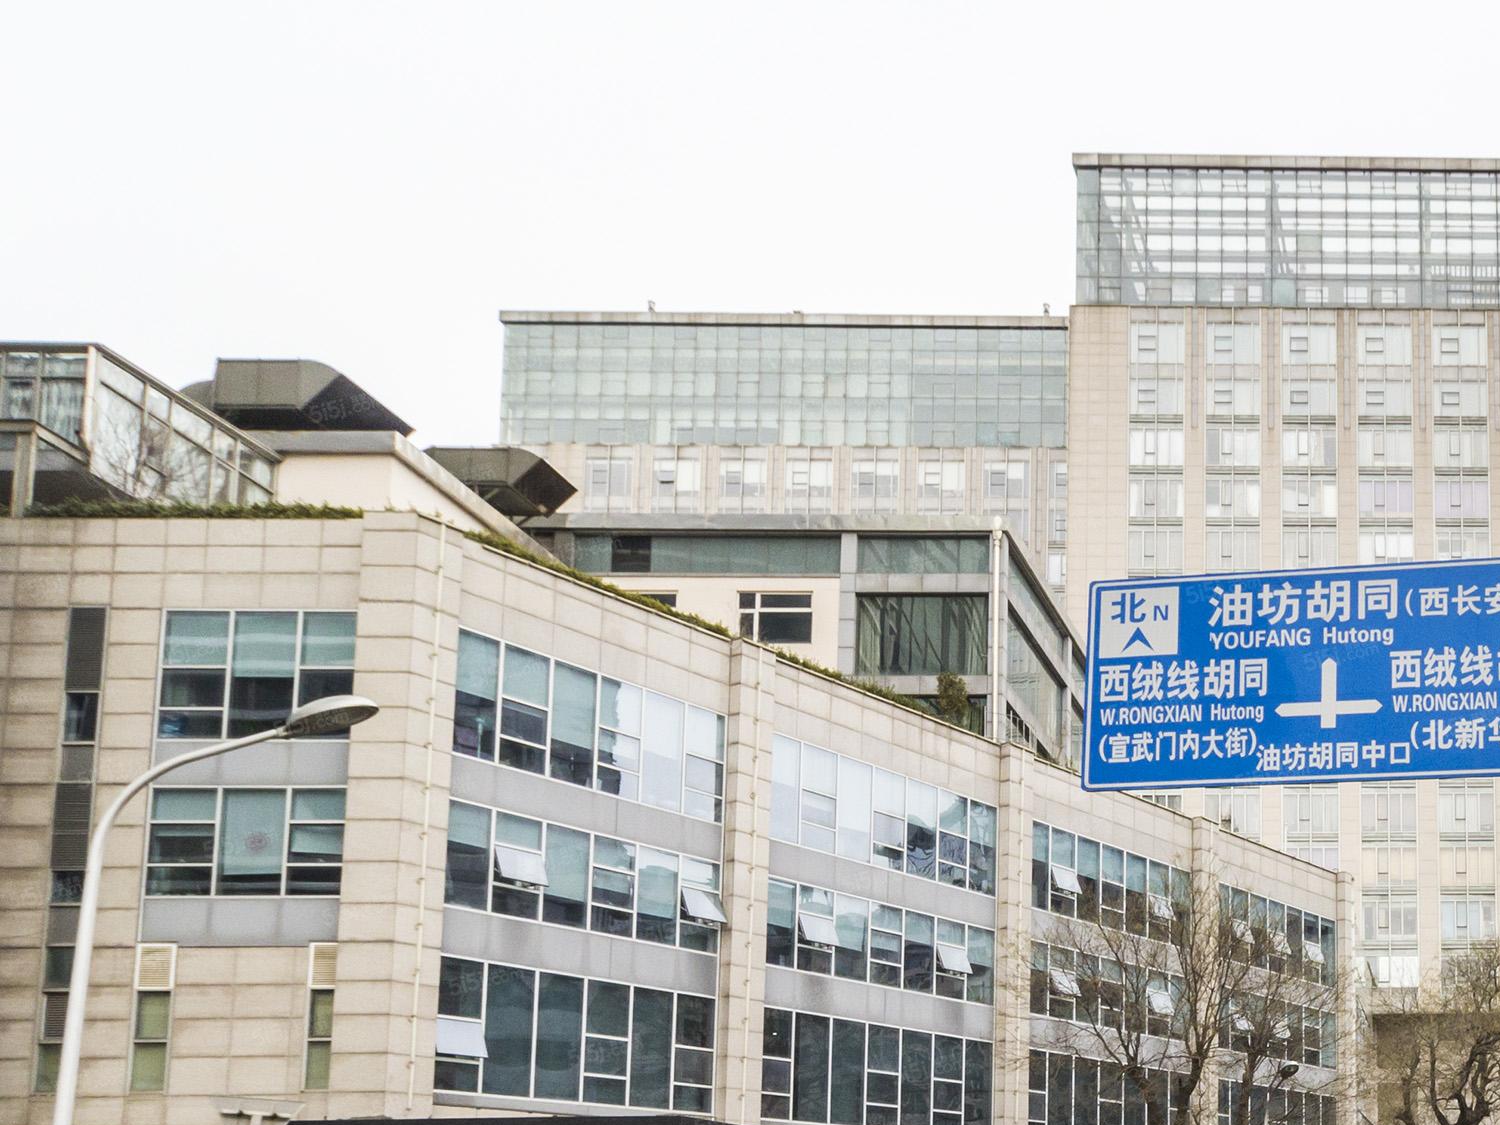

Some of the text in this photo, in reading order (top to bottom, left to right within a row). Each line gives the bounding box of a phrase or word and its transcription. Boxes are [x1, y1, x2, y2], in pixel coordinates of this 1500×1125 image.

[1111, 592, 1147, 625] 北
[1153, 605, 1169, 622] N
[1208, 579, 1399, 628] 油坊胡同
[1210, 626, 1395, 650] YOUFANG Hutong
[1099, 658, 1269, 703] 西绒线胡同
[1100, 702, 1265, 727] W.RONGXIAN Hutong
[1392, 691, 1498, 713] W.RONGXIAN
[1099, 727, 1258, 764] (宣武门内大街)
[1255, 740, 1411, 772] 油坊胡同中口
